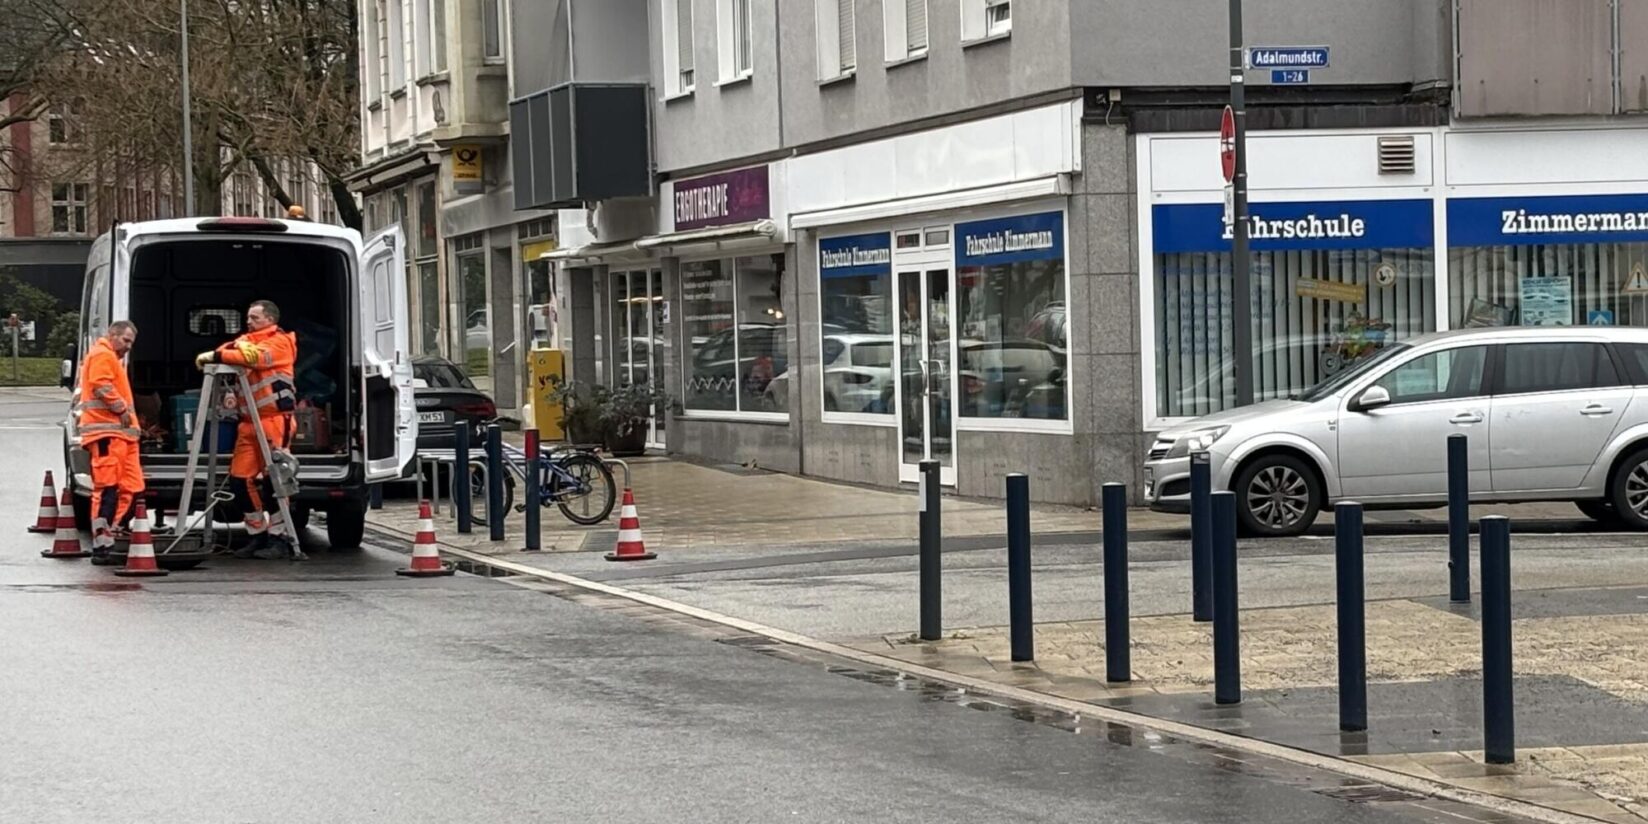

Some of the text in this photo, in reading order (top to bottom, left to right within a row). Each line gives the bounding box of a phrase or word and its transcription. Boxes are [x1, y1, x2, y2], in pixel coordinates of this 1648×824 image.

[1255, 50, 1323, 64] Adalmundstr.
[1282, 71, 1304, 82] 1-26
[676, 183, 728, 223] ERGOTHERAPIE
[965, 229, 1053, 256] Fahrschule Zimmermann
[822, 246, 890, 269] Fahrschule Zimmermann
